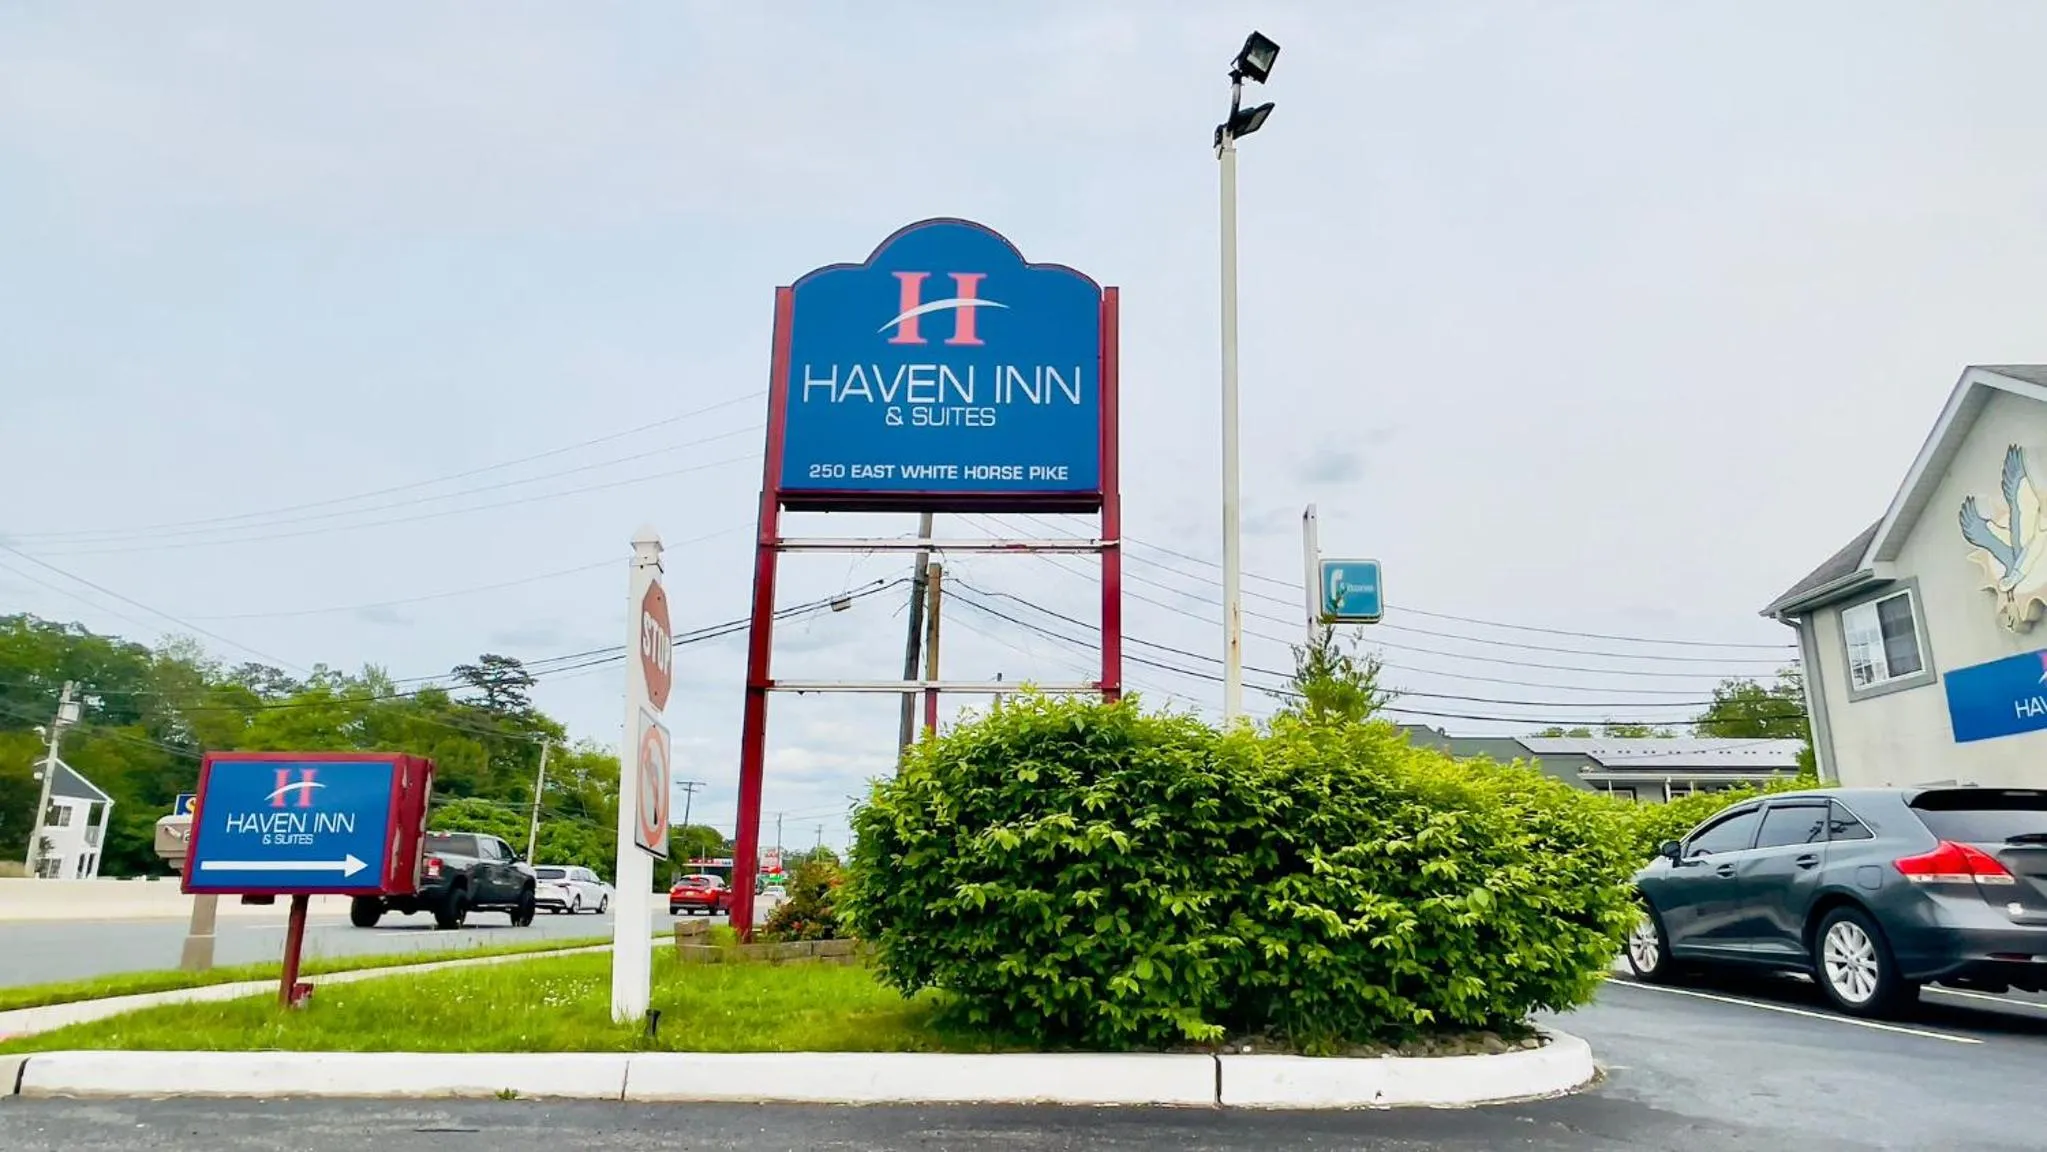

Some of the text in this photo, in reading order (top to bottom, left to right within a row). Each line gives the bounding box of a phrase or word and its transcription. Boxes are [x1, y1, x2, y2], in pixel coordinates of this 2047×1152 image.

[803, 364, 1081, 405] HAVEN INN
[885, 406, 996, 427] & SUITES
[809, 463, 1068, 481] 250 EAST WHITE HORSE PIKE
[643, 610, 671, 676] STOP
[226, 812, 356, 834] HAVEN INN
[262, 834, 314, 845] & SUITES
